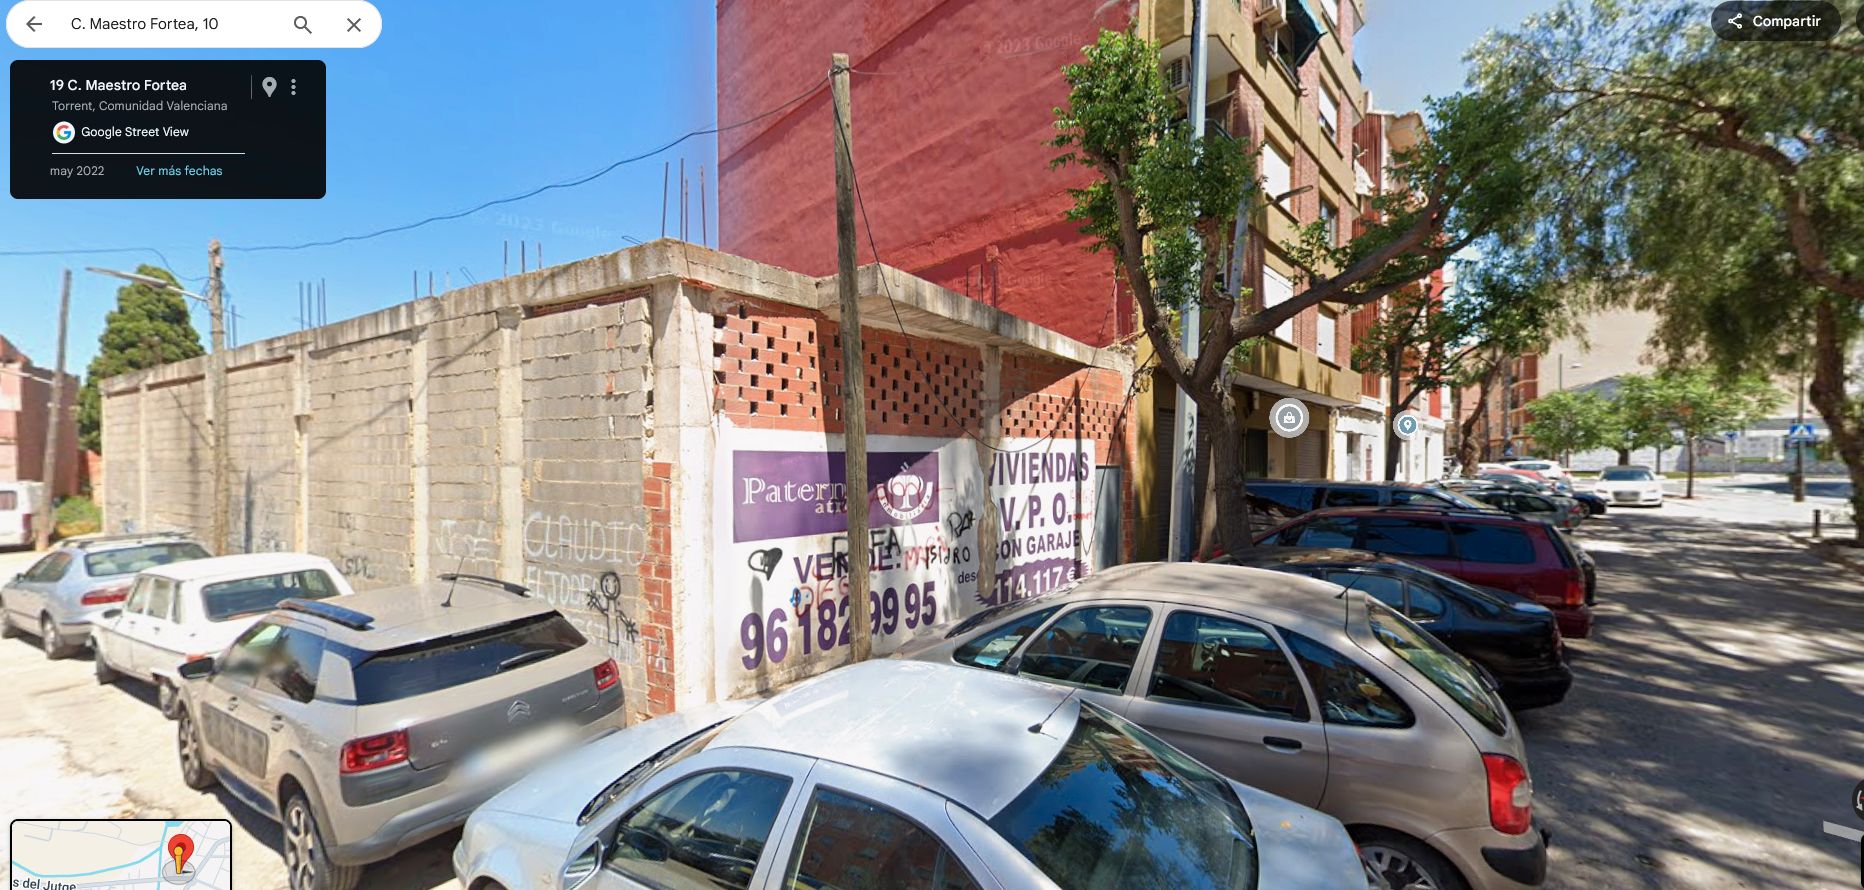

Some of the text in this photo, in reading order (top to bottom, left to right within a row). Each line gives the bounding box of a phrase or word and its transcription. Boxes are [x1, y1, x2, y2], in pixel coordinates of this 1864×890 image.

[742, 477, 848, 504] Patern
[1000, 492, 1072, 532] V. P. O.
[525, 512, 646, 566] CLAUDIO
[1026, 530, 1080, 555] GARAJE
[1066, 566, 1076, 582] €
[740, 607, 788, 671] 96
[905, 581, 937, 629] 95
